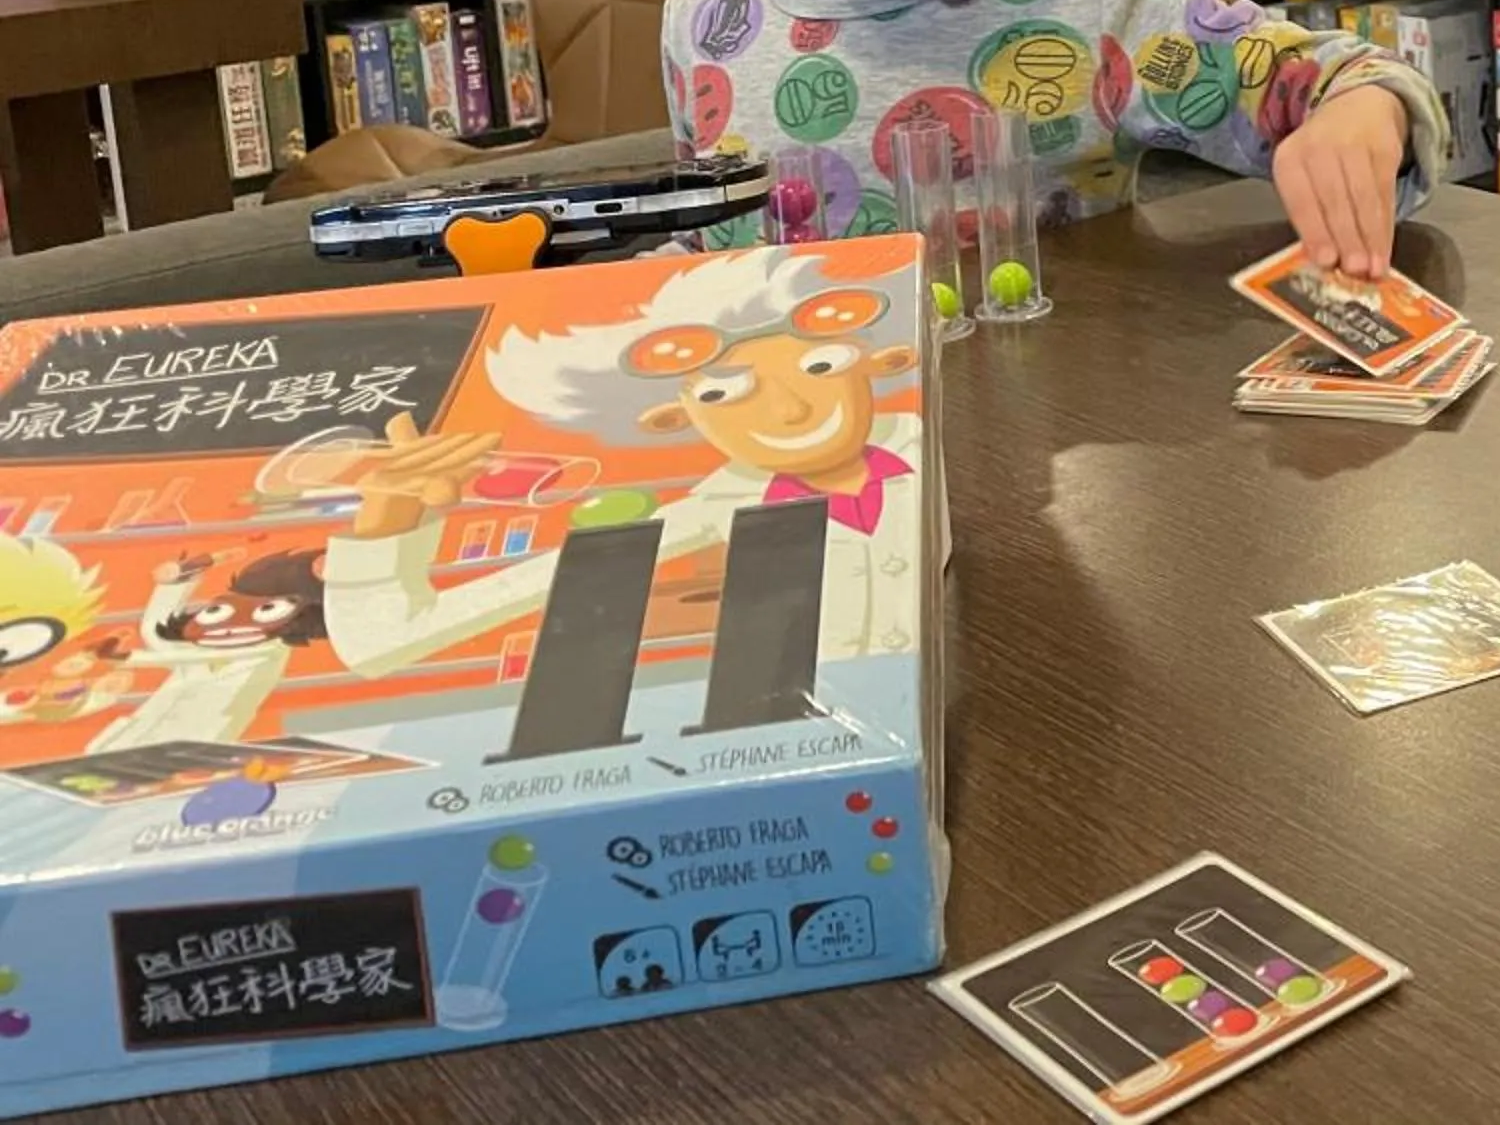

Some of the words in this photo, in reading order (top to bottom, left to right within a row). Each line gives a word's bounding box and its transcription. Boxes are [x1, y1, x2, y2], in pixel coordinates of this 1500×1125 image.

[103, 335, 279, 383] EUREKA
[0, 365, 418, 440] 瘋狂科學家
[479, 777, 563, 805] ROBERTO
[572, 765, 633, 793] FRAGA
[659, 826, 742, 859] ROBERTO
[750, 816, 810, 846] FRAGA
[765, 848, 833, 879] ESCAPA
[178, 919, 295, 965] EUREKA
[138, 946, 413, 1028] 瘋狂科學家
